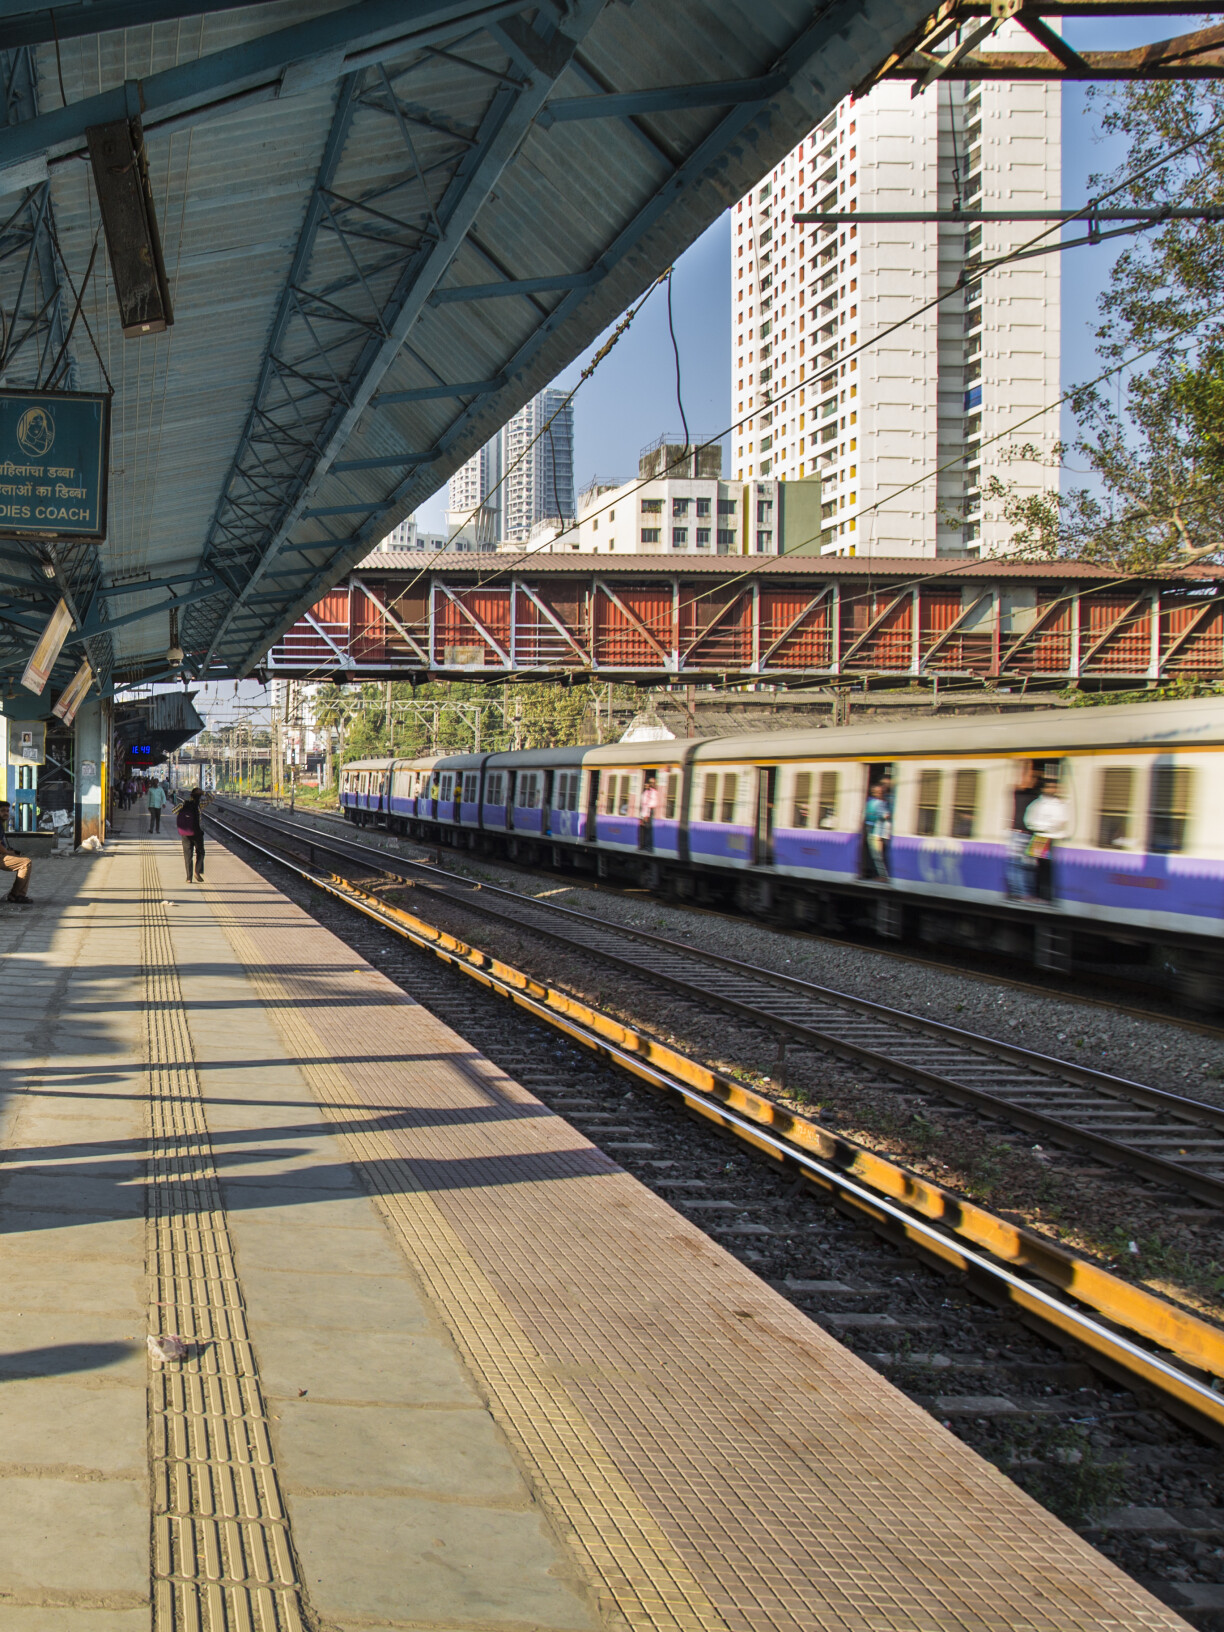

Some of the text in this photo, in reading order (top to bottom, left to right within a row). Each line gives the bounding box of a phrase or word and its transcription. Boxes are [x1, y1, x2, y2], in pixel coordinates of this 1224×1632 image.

[47, 466, 75, 478] डब्बा
[36, 486, 52, 498] का
[55, 483, 87, 499] डिब्बा
[35, 506, 90, 521] COACH
